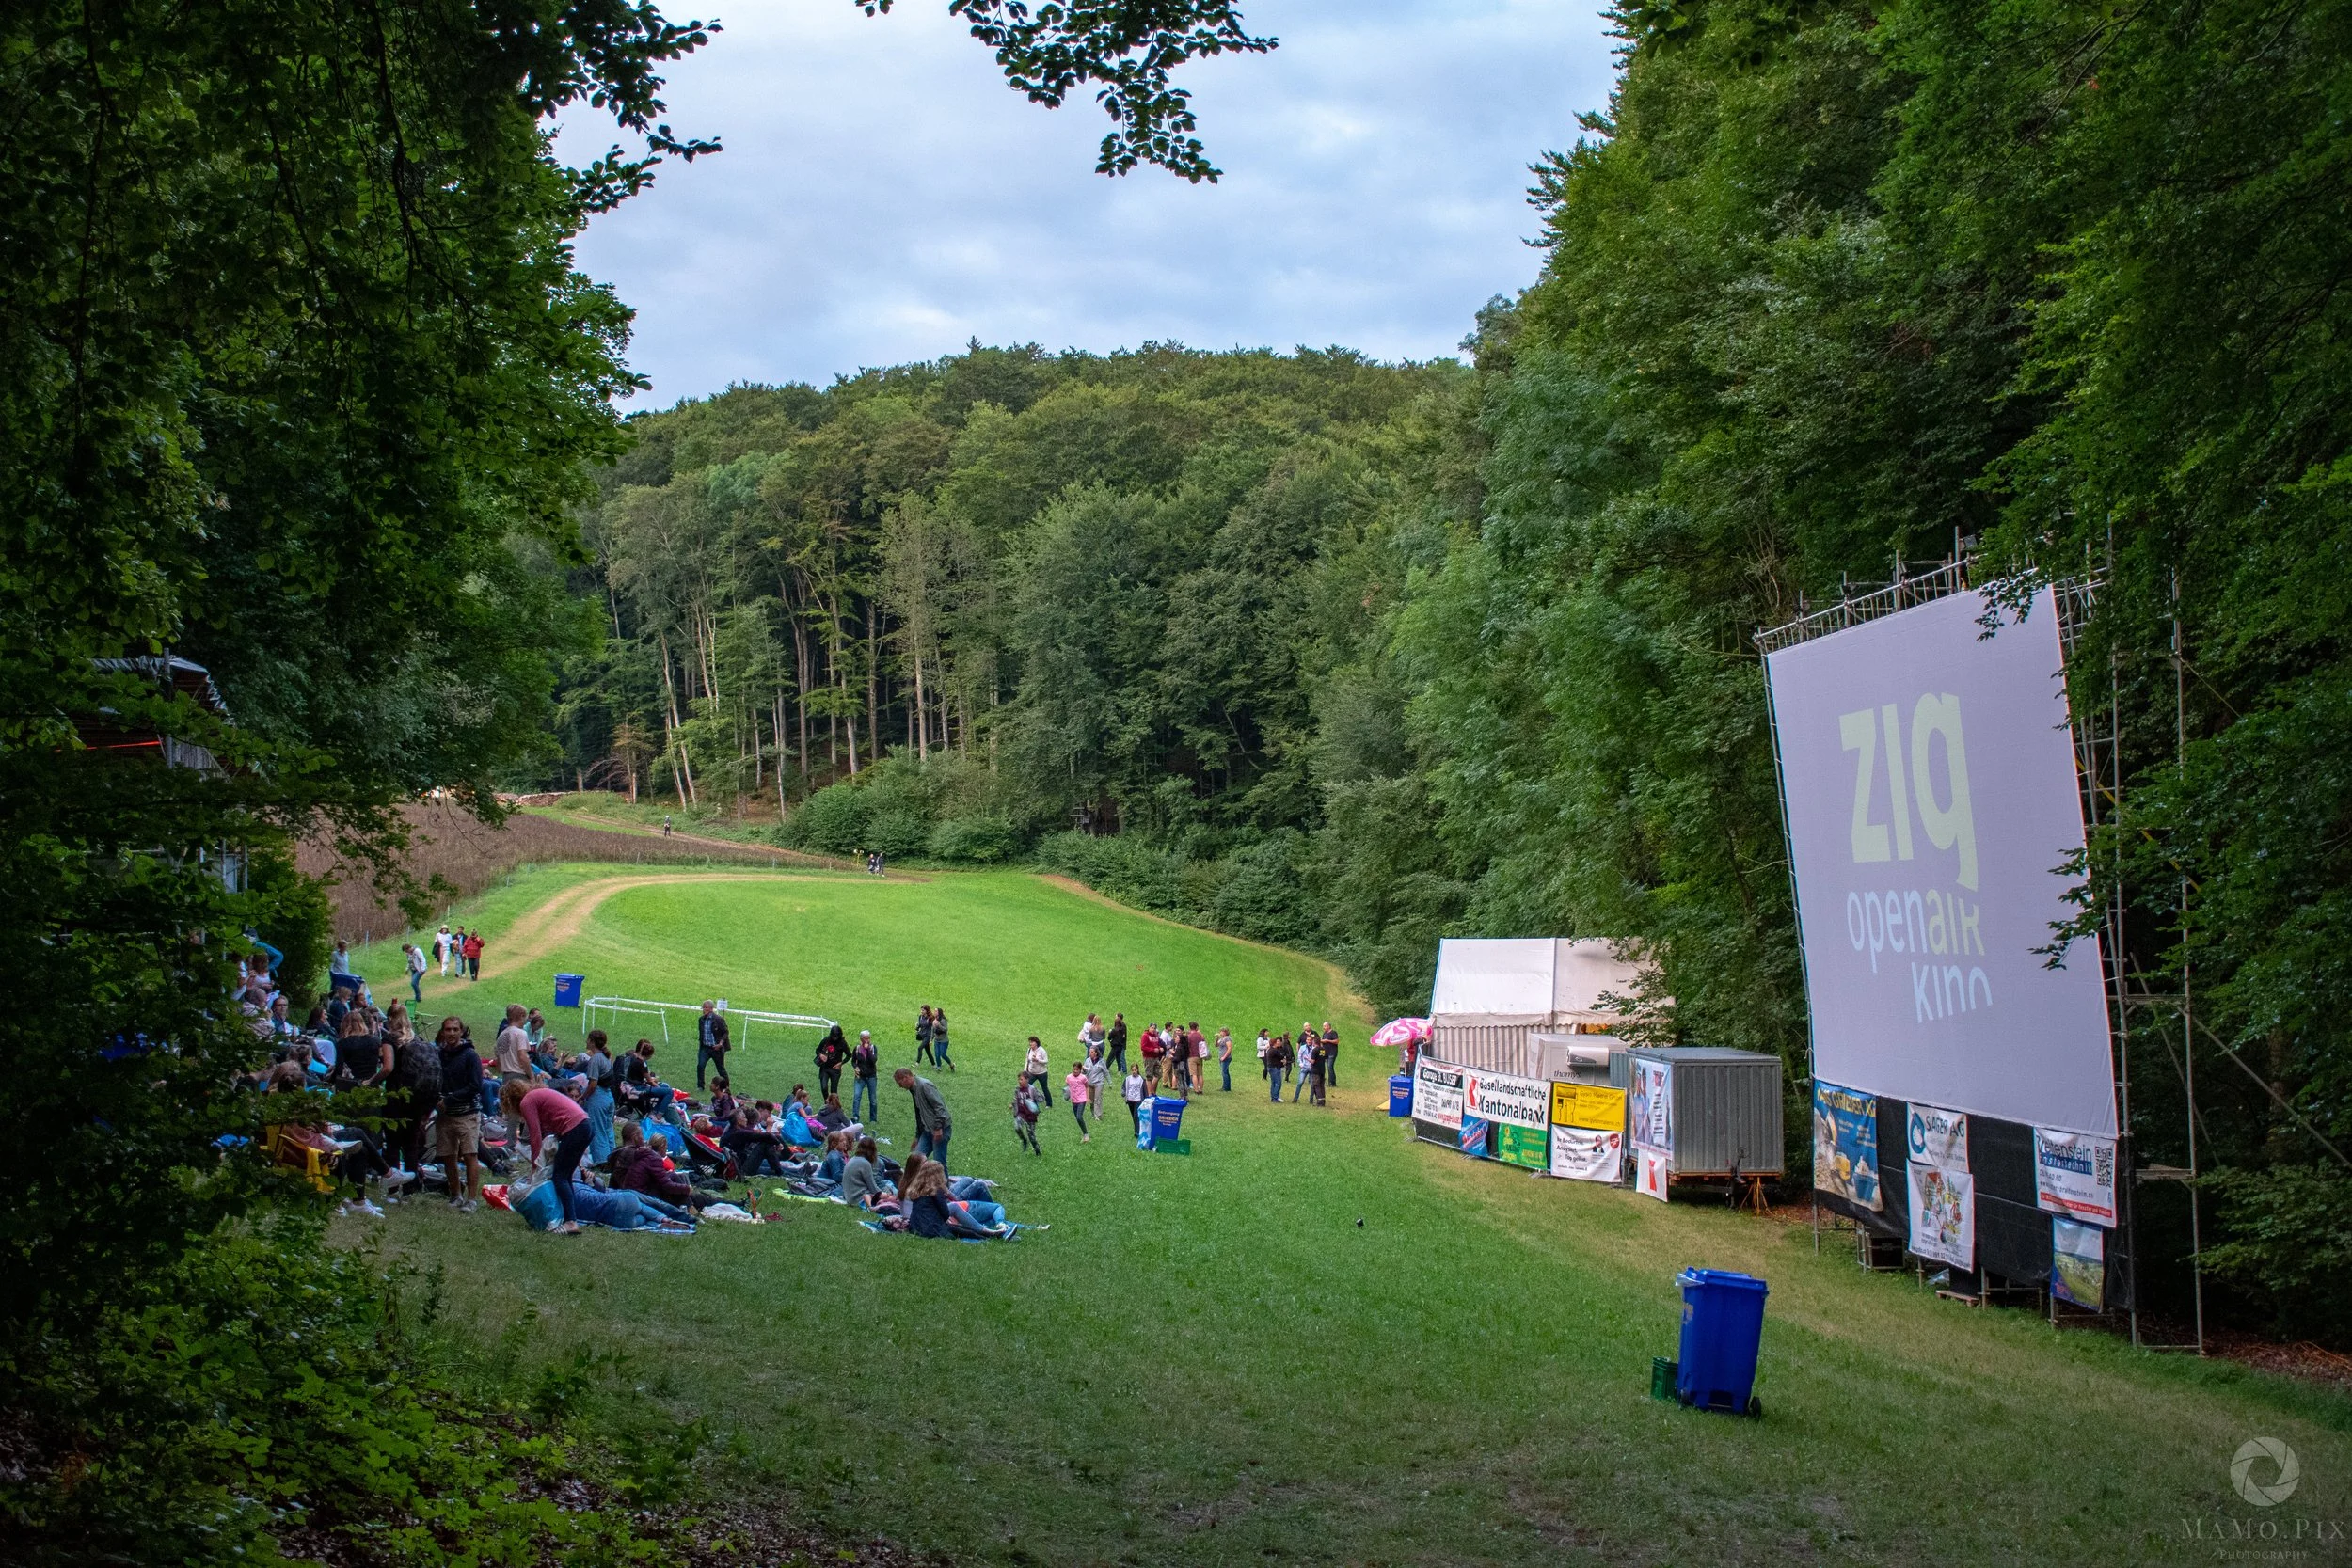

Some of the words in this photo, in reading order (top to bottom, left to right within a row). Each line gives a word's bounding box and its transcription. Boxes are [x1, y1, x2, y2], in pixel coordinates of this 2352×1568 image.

[1479, 1077, 1547, 1101] Basellandschaftliche
[1478, 1094, 1545, 1124] Kantonalbank
[1949, 1120, 1964, 1138] AG
